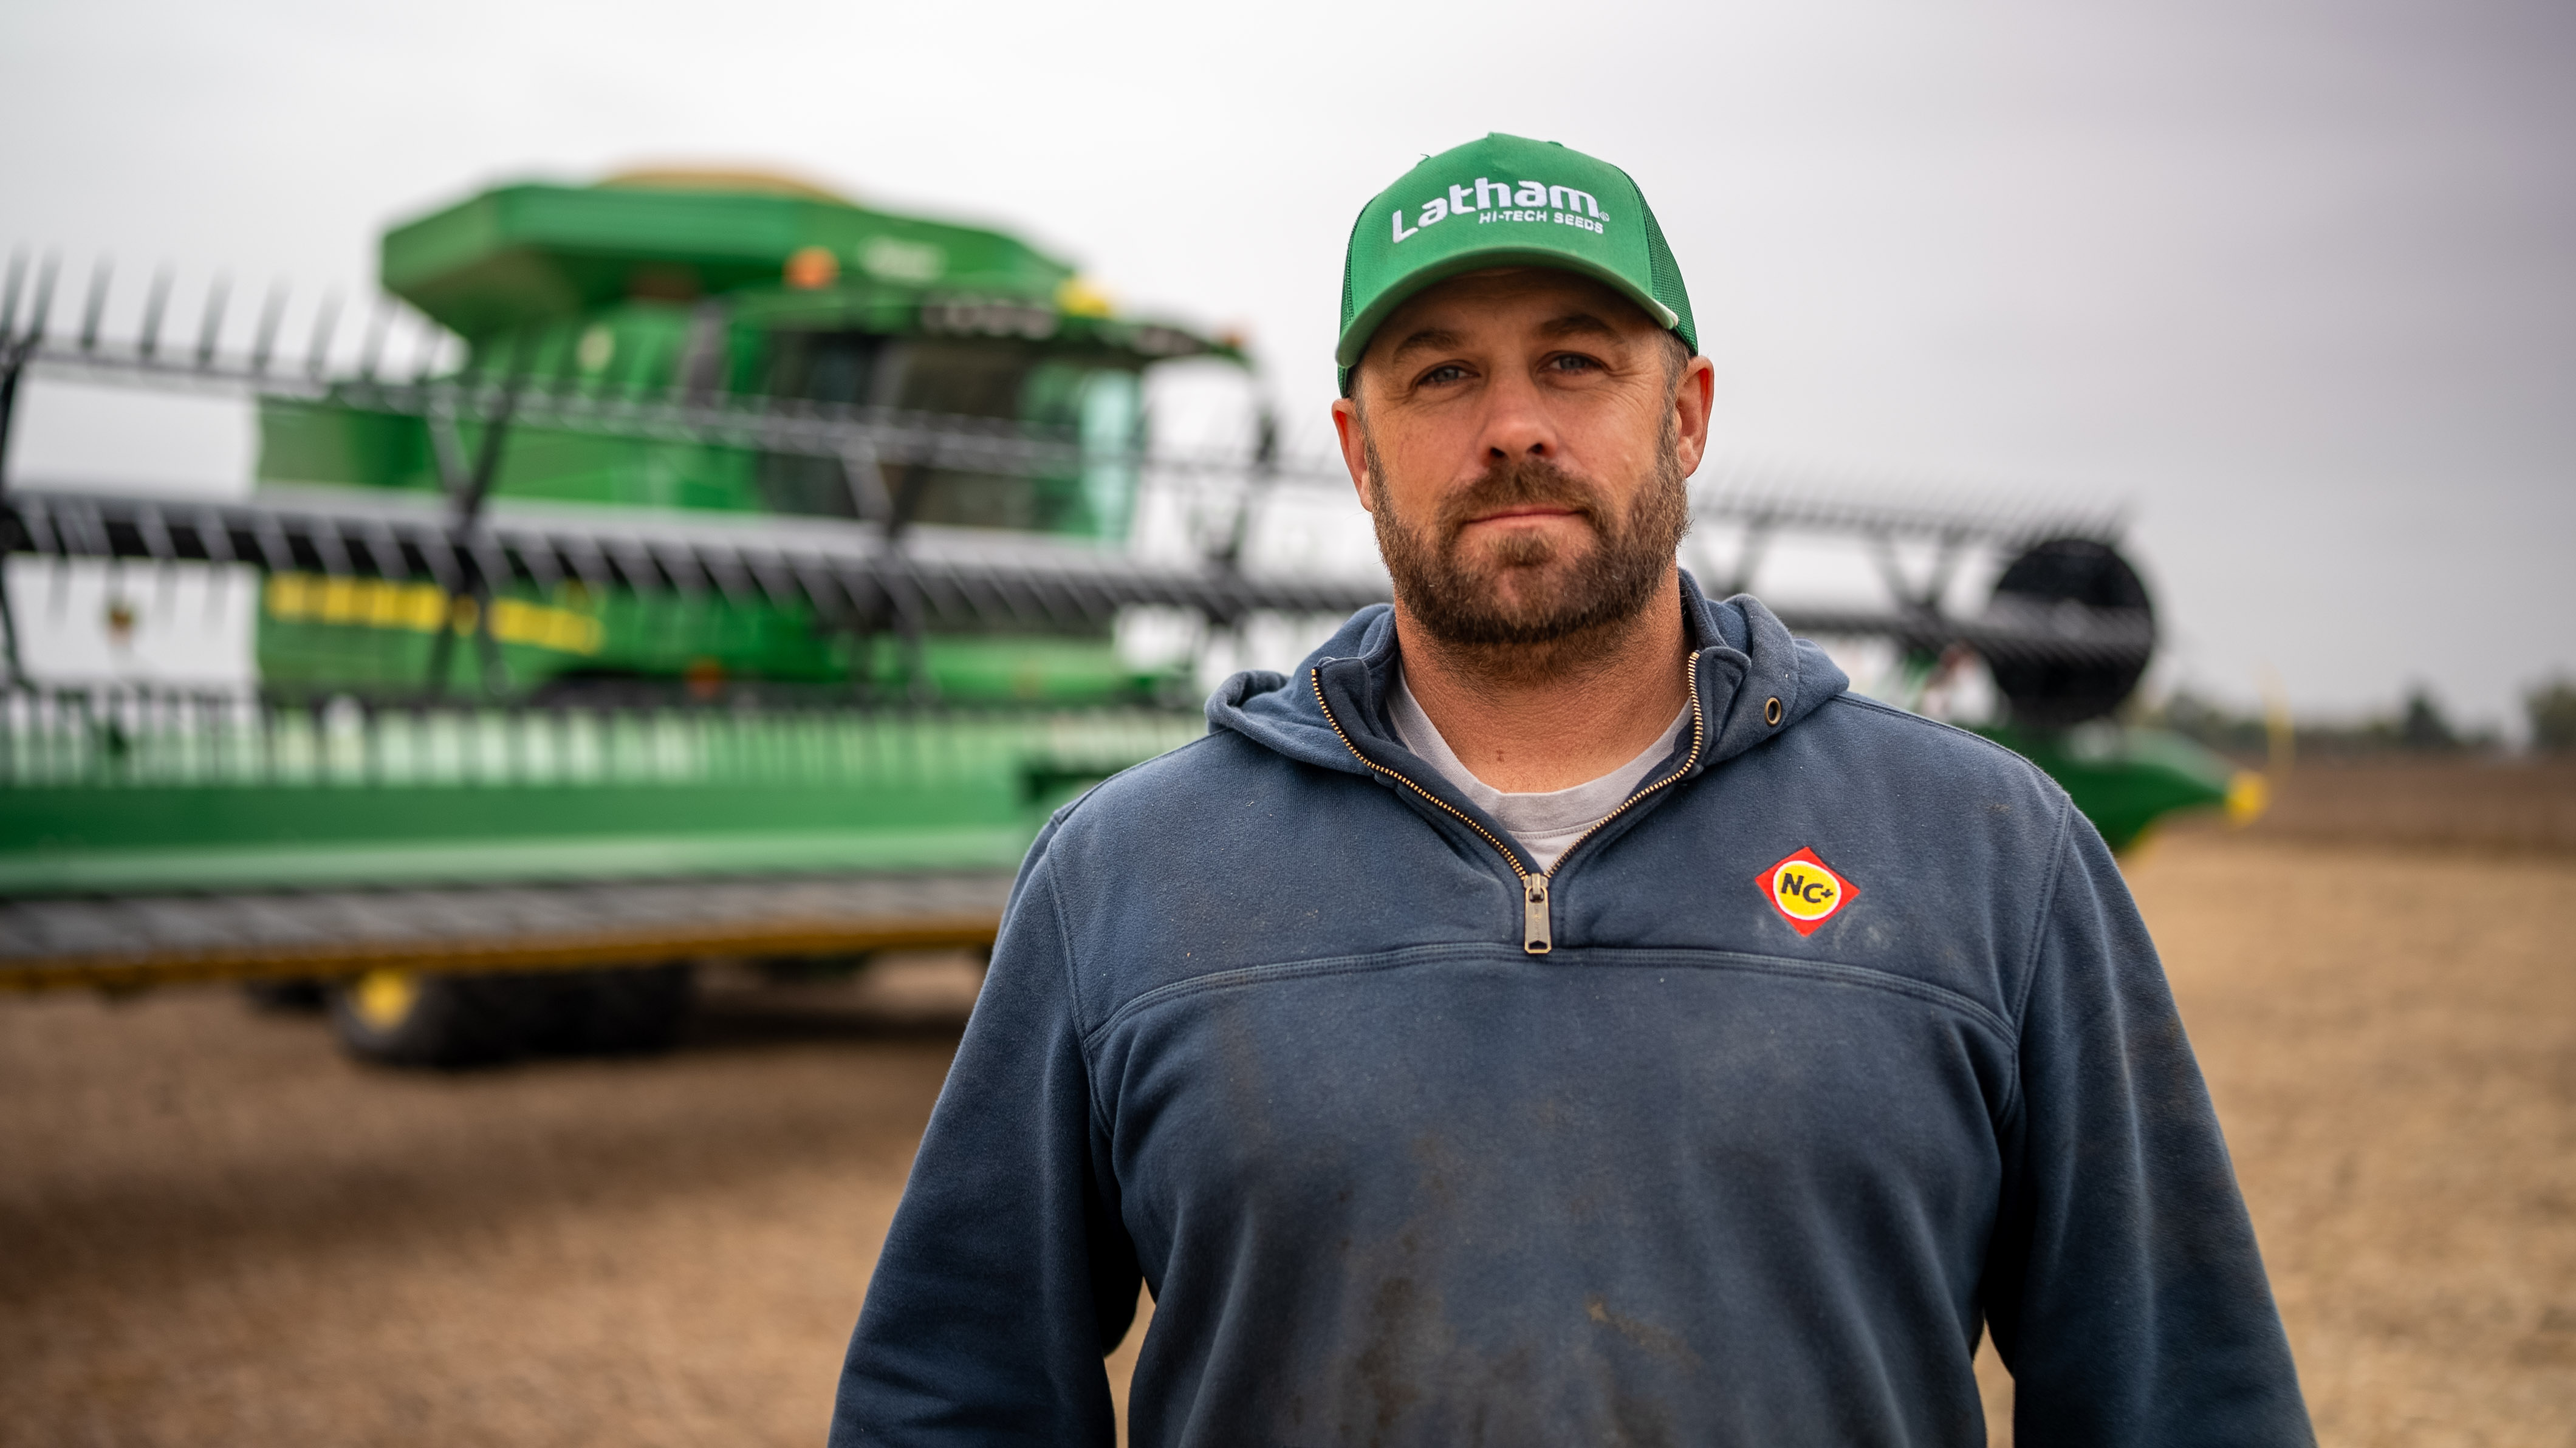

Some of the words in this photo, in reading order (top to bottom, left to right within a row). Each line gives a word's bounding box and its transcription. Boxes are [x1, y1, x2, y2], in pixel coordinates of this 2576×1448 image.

[1479, 210, 1547, 224] HI-TECH
[1553, 211, 1604, 234] SEEDS
[1781, 872, 1834, 903] NC+
